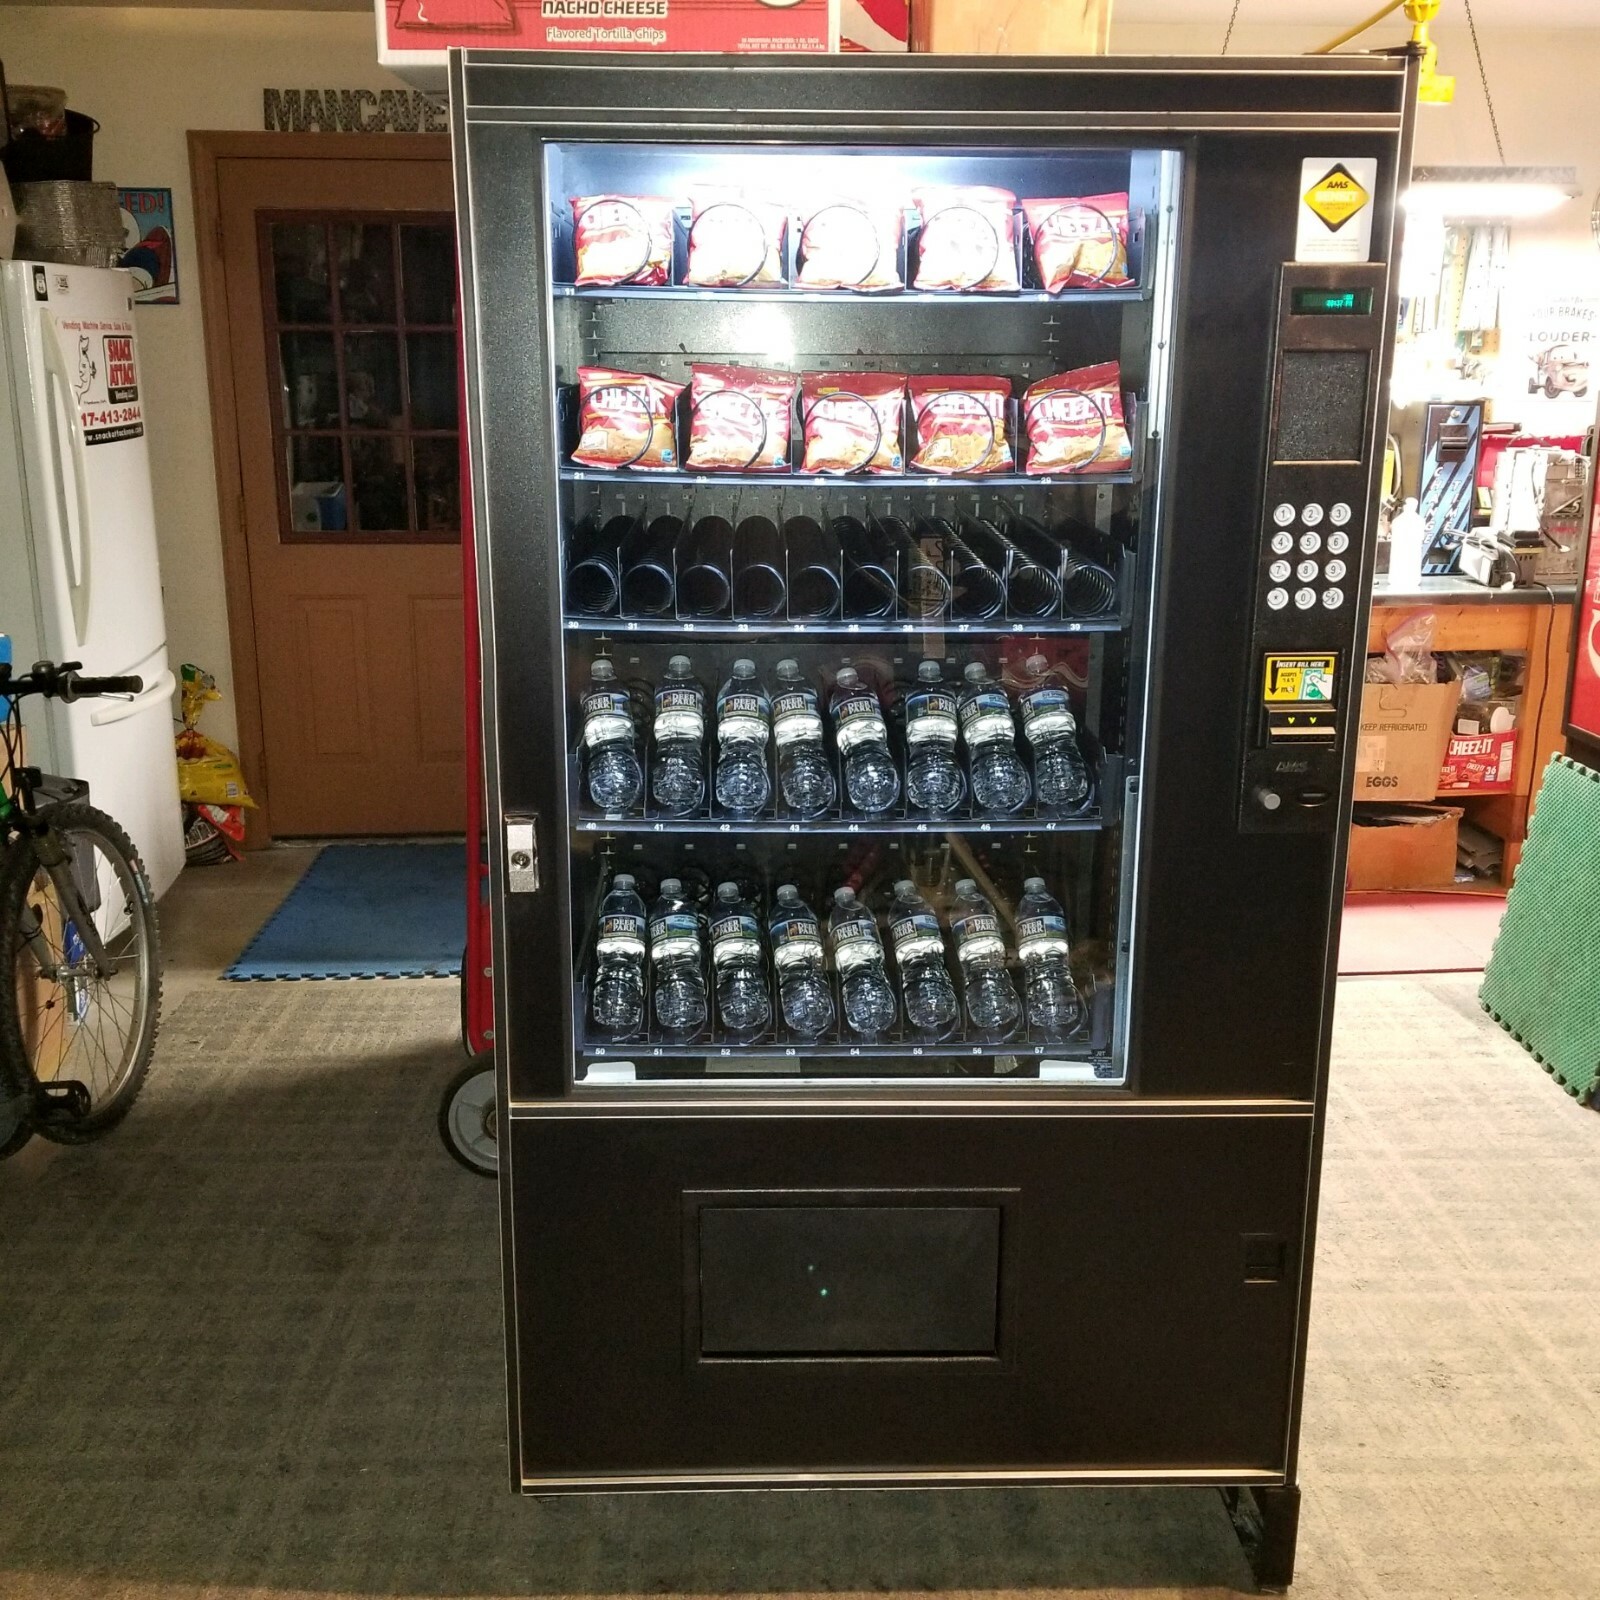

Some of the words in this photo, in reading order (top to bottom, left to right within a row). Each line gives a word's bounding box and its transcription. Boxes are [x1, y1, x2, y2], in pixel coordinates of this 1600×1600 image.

[542, 0, 599, 15] NACHO
[603, 0, 666, 15] CHEESE
[547, 27, 592, 39] Flavored
[595, 27, 632, 39] Tortilla
[634, 27, 664, 41] Chips
[1327, 181, 1349, 189] AMS
[118, 191, 164, 214] ED!
[108, 339, 132, 362] SNACK
[110, 363, 136, 387] ATTACK
[574, 472, 584, 480] 21
[1423, 466, 1444, 544] CHANGE
[1444, 480, 1462, 531] TIME
[568, 621, 579, 629] 30
[628, 622, 638, 630] 31
[684, 623, 694, 631] 32
[794, 624, 805, 632] 34
[959, 624, 969, 632] 37
[1070, 623, 1081, 631] 39
[1276, 660, 1296, 668] INSERT
[1310, 660, 1325, 668] HERE
[1360, 723, 1378, 731] KEEP
[1379, 723, 1427, 732] REFRIGERATED
[1485, 765, 1496, 775] 36
[1366, 776, 1398, 788] EGGS
[586, 822, 597, 830] 40
[654, 823, 664, 831] 41
[720, 824, 731, 832] 42
[790, 824, 800, 832] 43
[980, 823, 991, 831] 46
[1046, 822, 1056, 830] 47
[595, 1047, 606, 1055] 50
[653, 1048, 663, 1056] 51
[720, 1048, 731, 1056] 52
[912, 1047, 923, 1055] 55
[1034, 1046, 1045, 1054] 57
